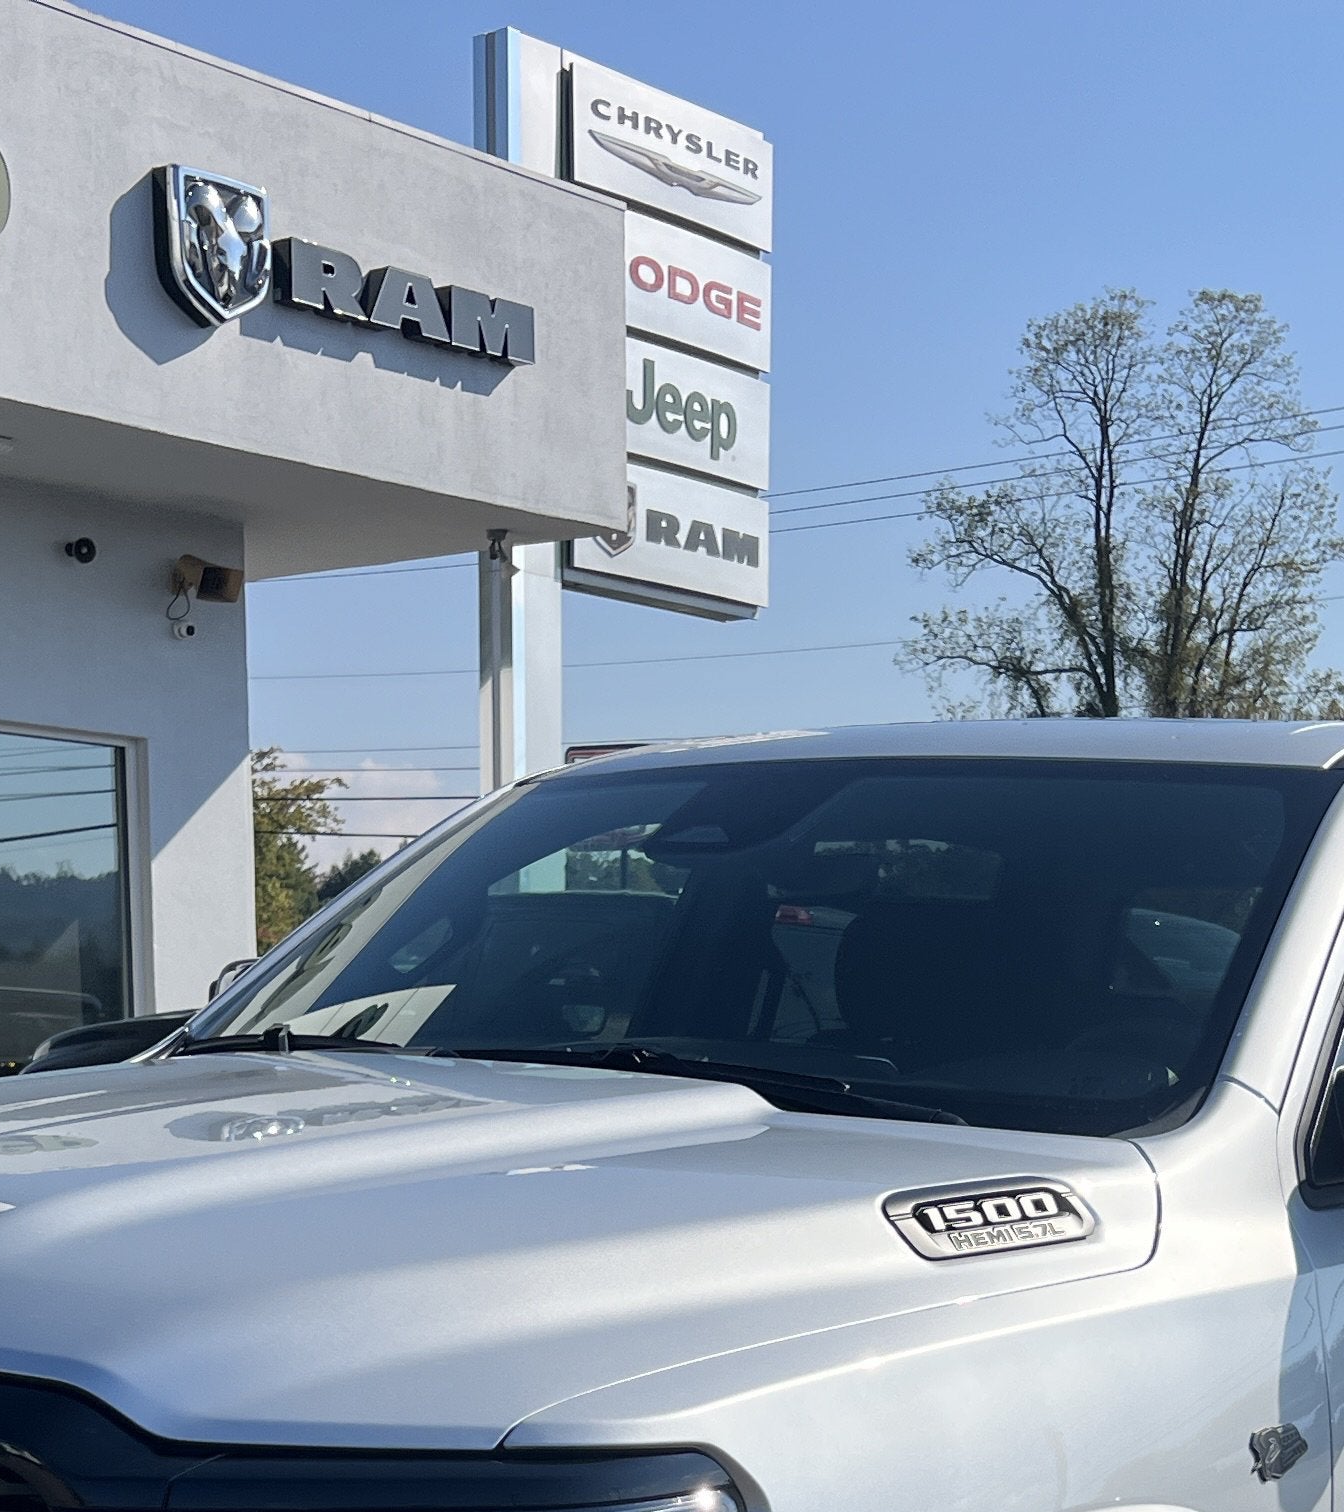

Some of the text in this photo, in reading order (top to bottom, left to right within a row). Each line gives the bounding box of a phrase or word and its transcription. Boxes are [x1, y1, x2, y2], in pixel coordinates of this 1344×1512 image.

[590, 98, 761, 181] CHRYSLER
[270, 236, 536, 366] RAM
[629, 255, 762, 332] ODGE
[626, 357, 738, 461] Jeep
[646, 508, 760, 569] RAM
[916, 1191, 1058, 1232] 1500
[948, 1220, 1066, 1251] HEMI 5.7L
